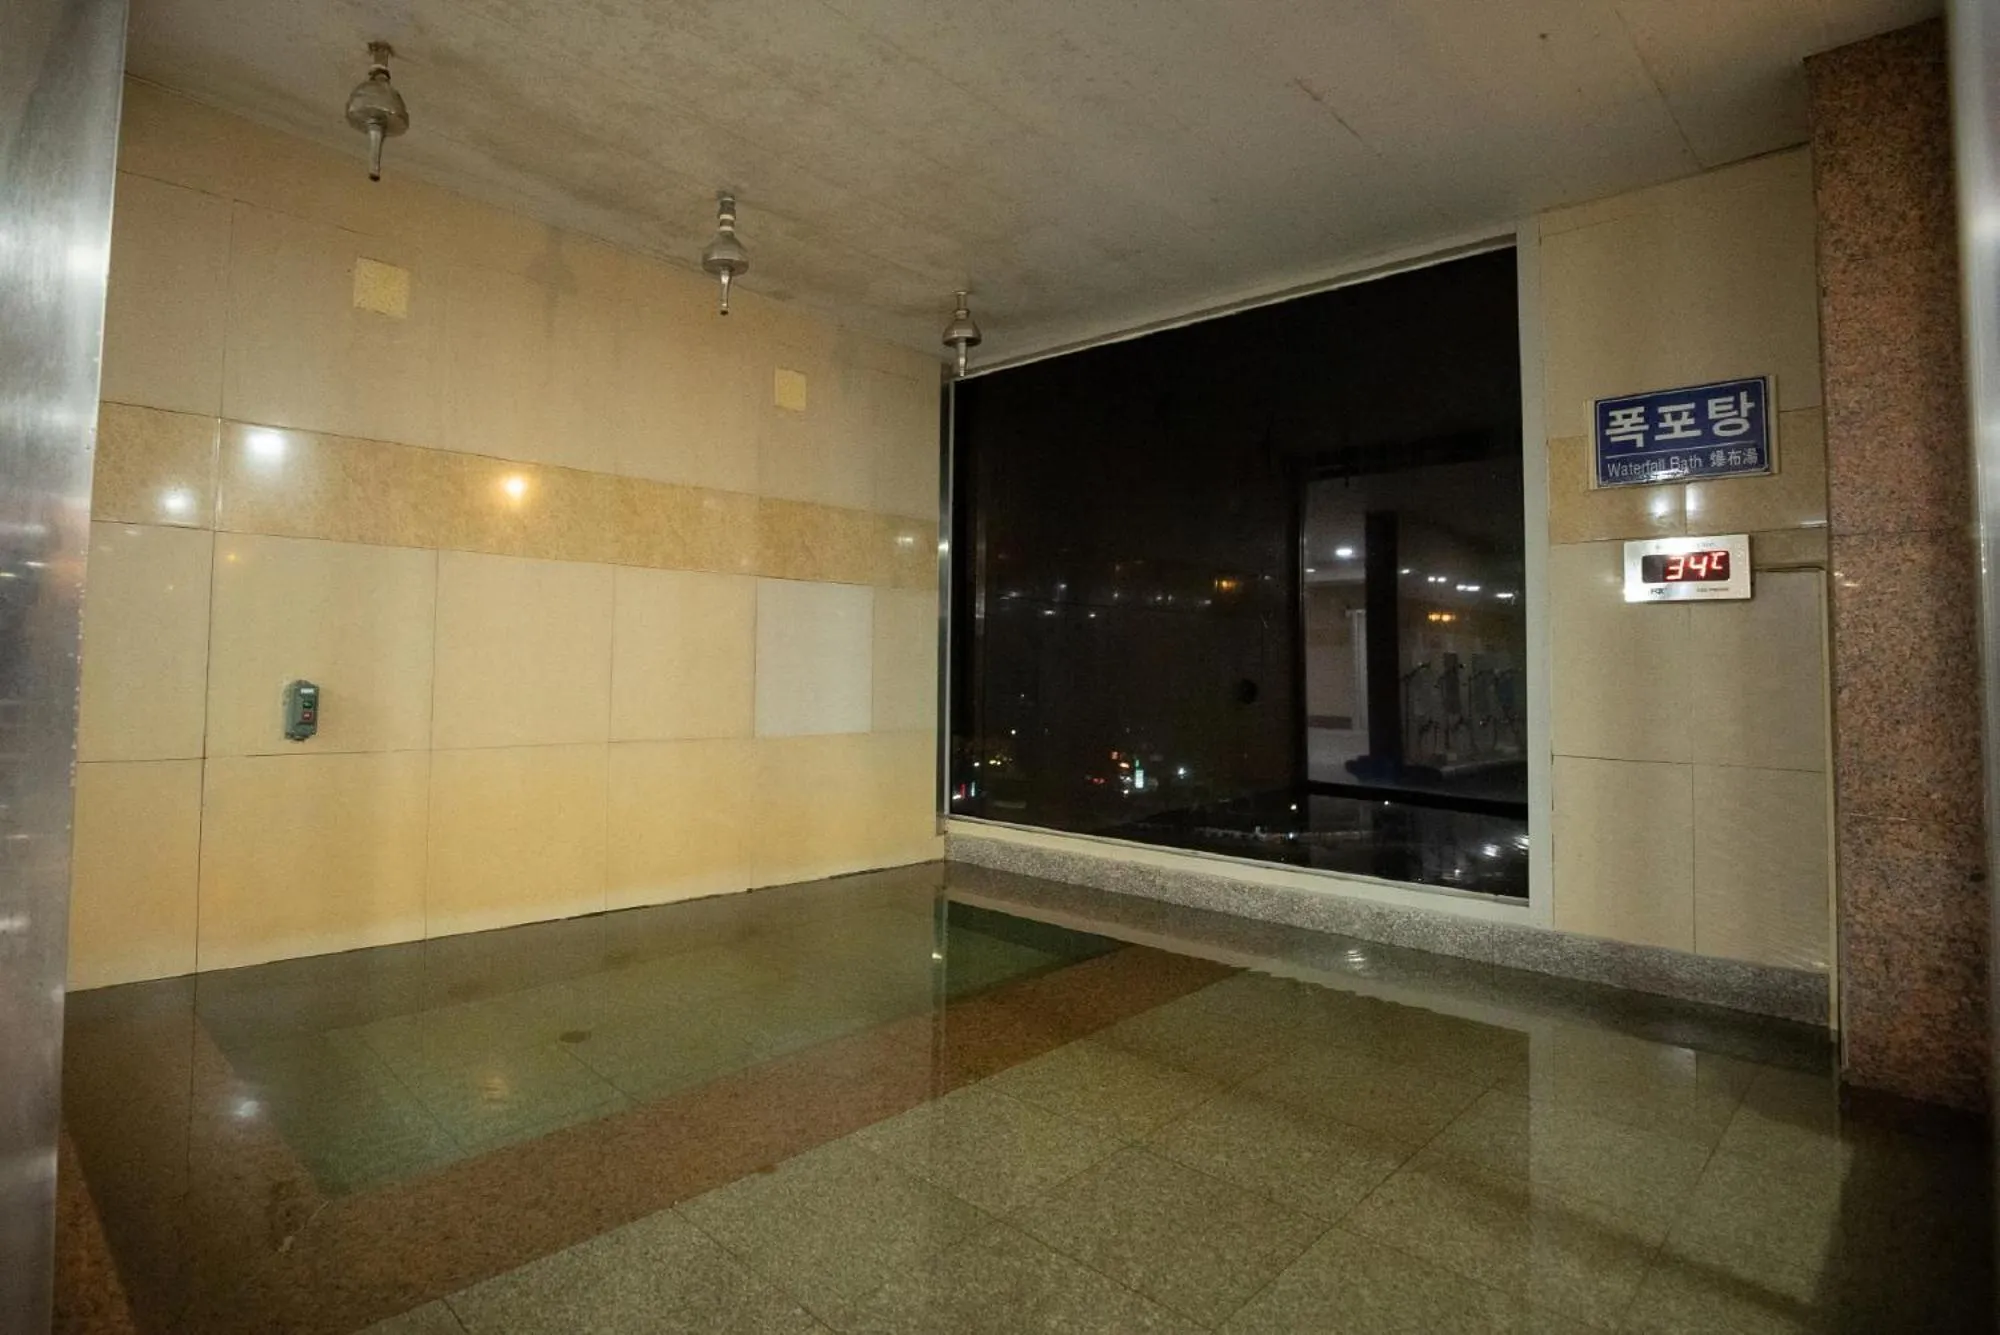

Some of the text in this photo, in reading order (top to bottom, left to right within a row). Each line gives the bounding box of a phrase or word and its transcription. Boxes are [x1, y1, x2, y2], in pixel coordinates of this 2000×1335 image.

[1605, 391, 1755, 448] 폭포탕
[1607, 455, 1703, 478] Waterfall Bath
